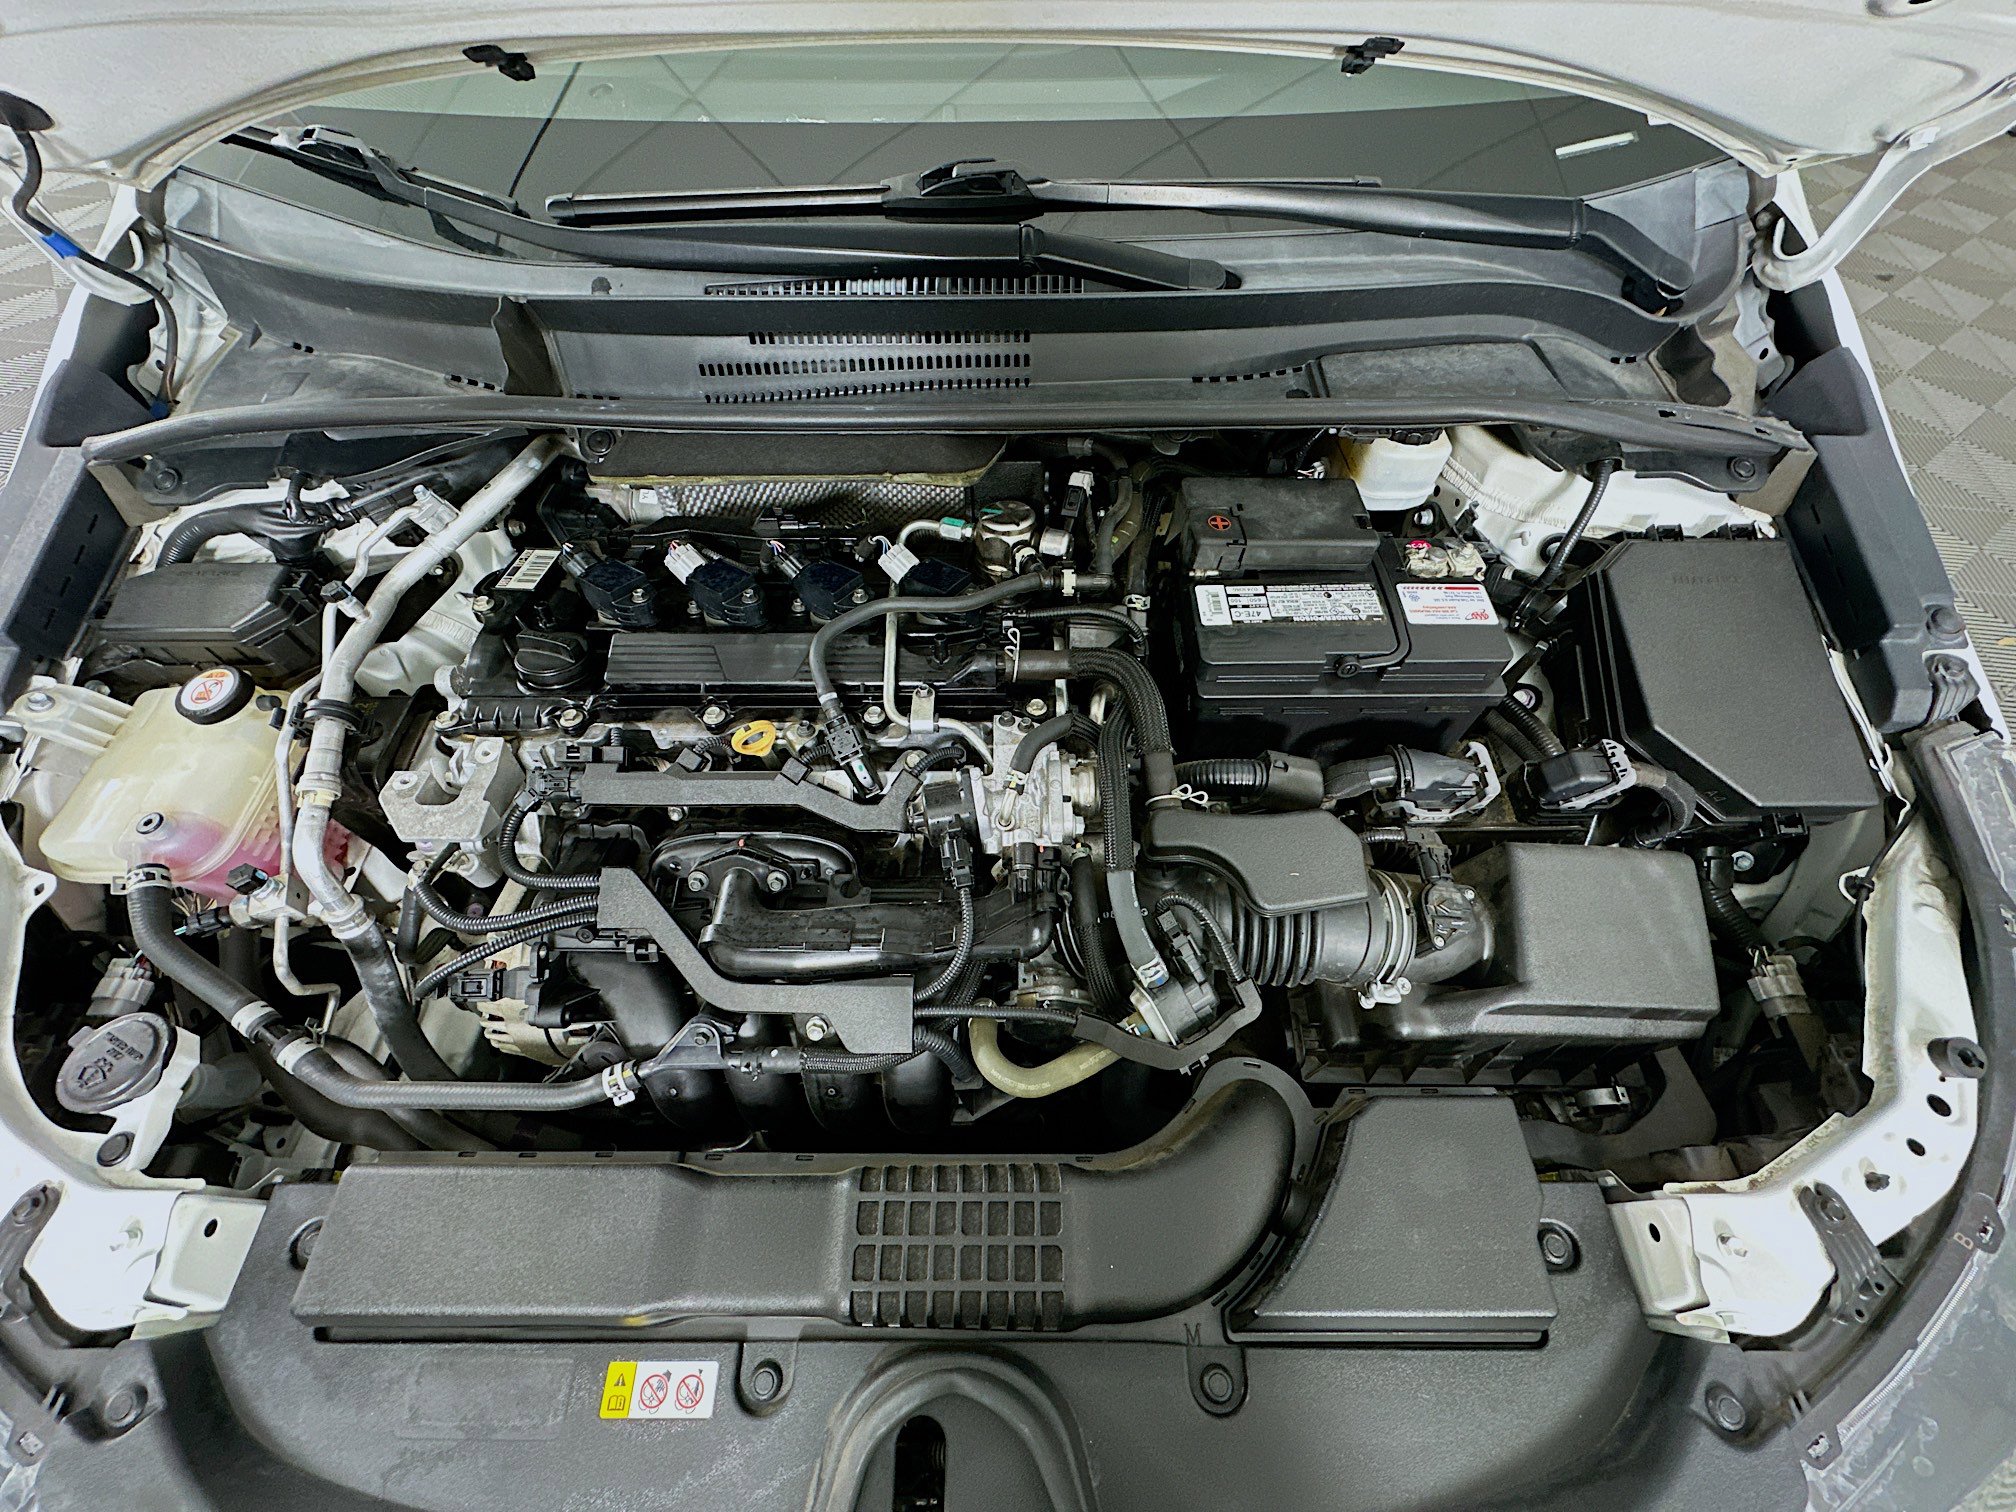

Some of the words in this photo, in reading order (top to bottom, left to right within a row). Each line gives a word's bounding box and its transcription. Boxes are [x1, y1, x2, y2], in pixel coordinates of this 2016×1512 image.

[1234, 610, 1261, 618] 47E-C
[1953, 1232, 1974, 1250] B
[1184, 1323, 1201, 1347] M
